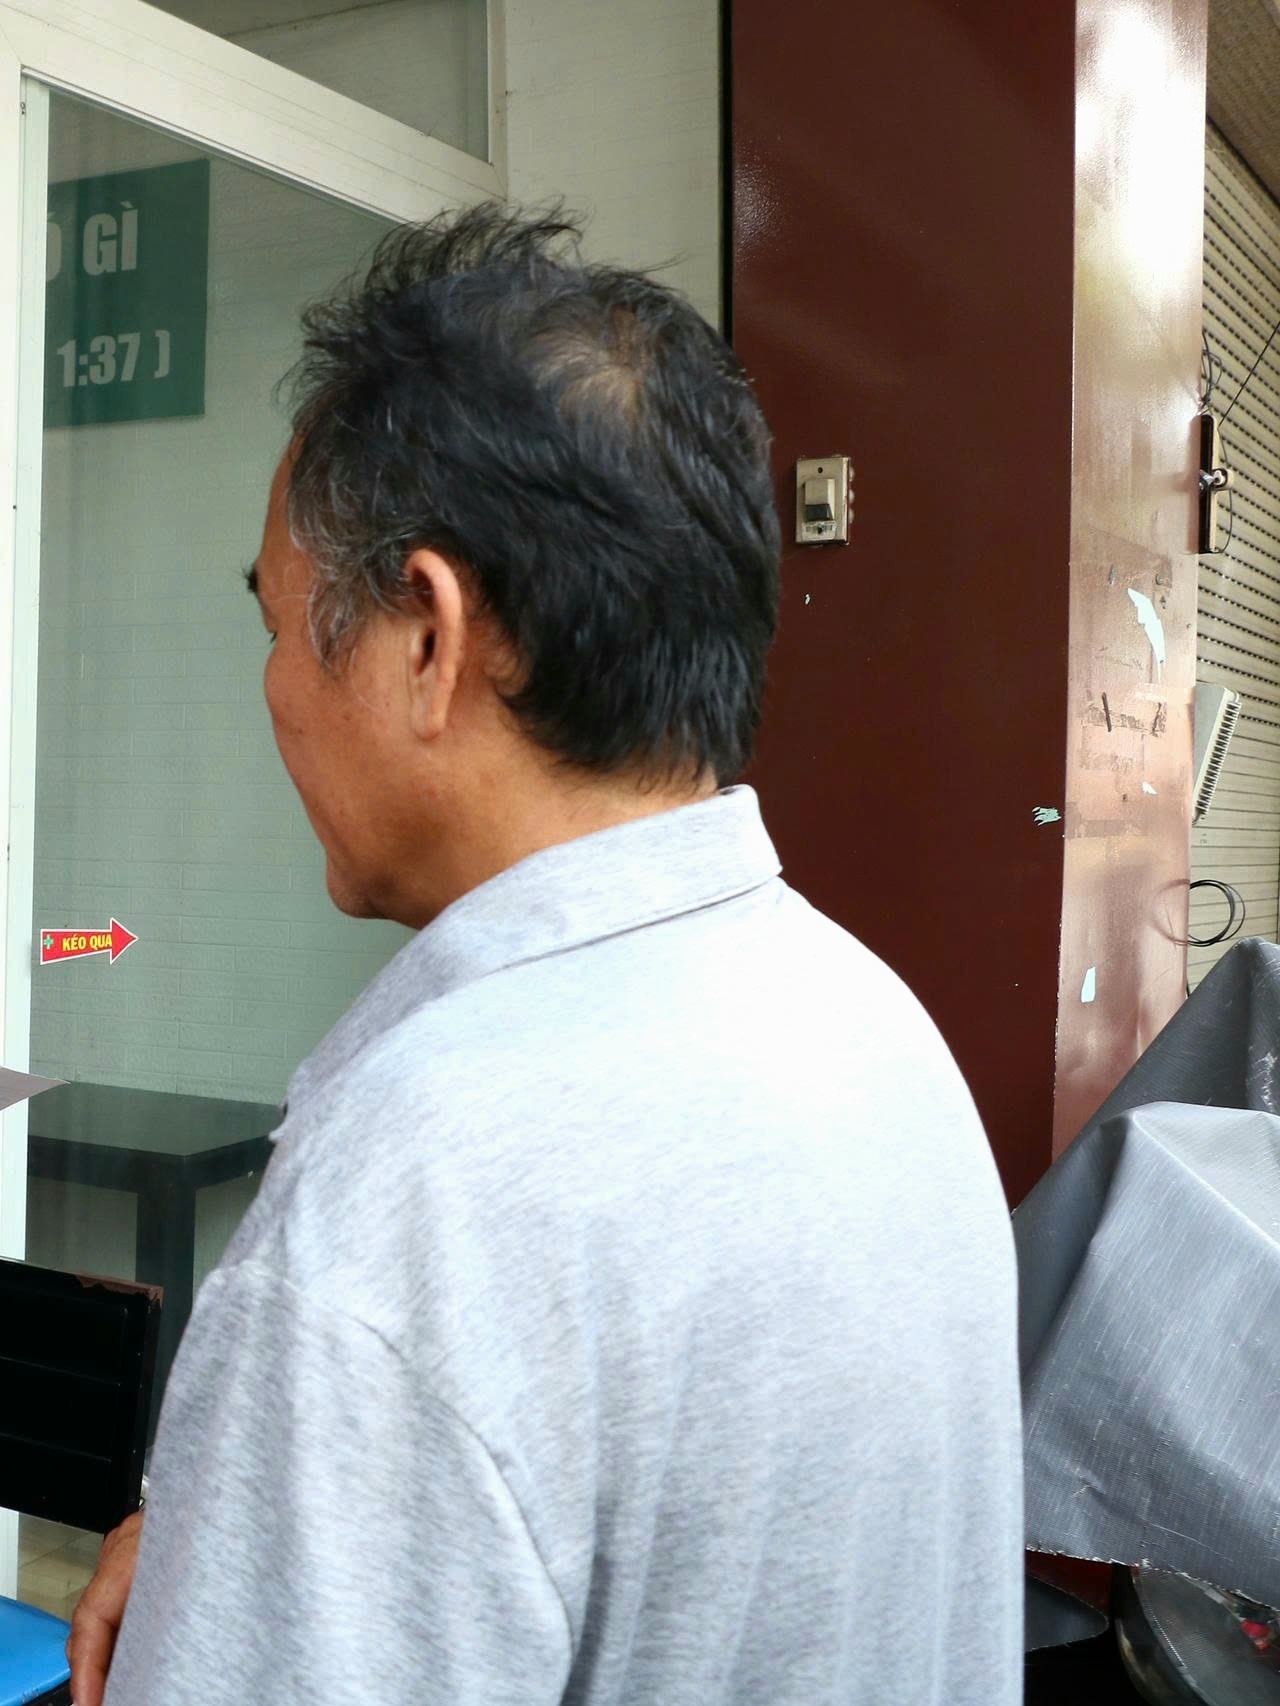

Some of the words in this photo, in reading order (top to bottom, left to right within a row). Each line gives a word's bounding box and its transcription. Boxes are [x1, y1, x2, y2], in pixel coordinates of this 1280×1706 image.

[83, 200, 138, 276] GÌ
[57, 332, 141, 387] 1:37
[62, 933, 86, 951] KÉO
[89, 934, 113, 950] QUA
